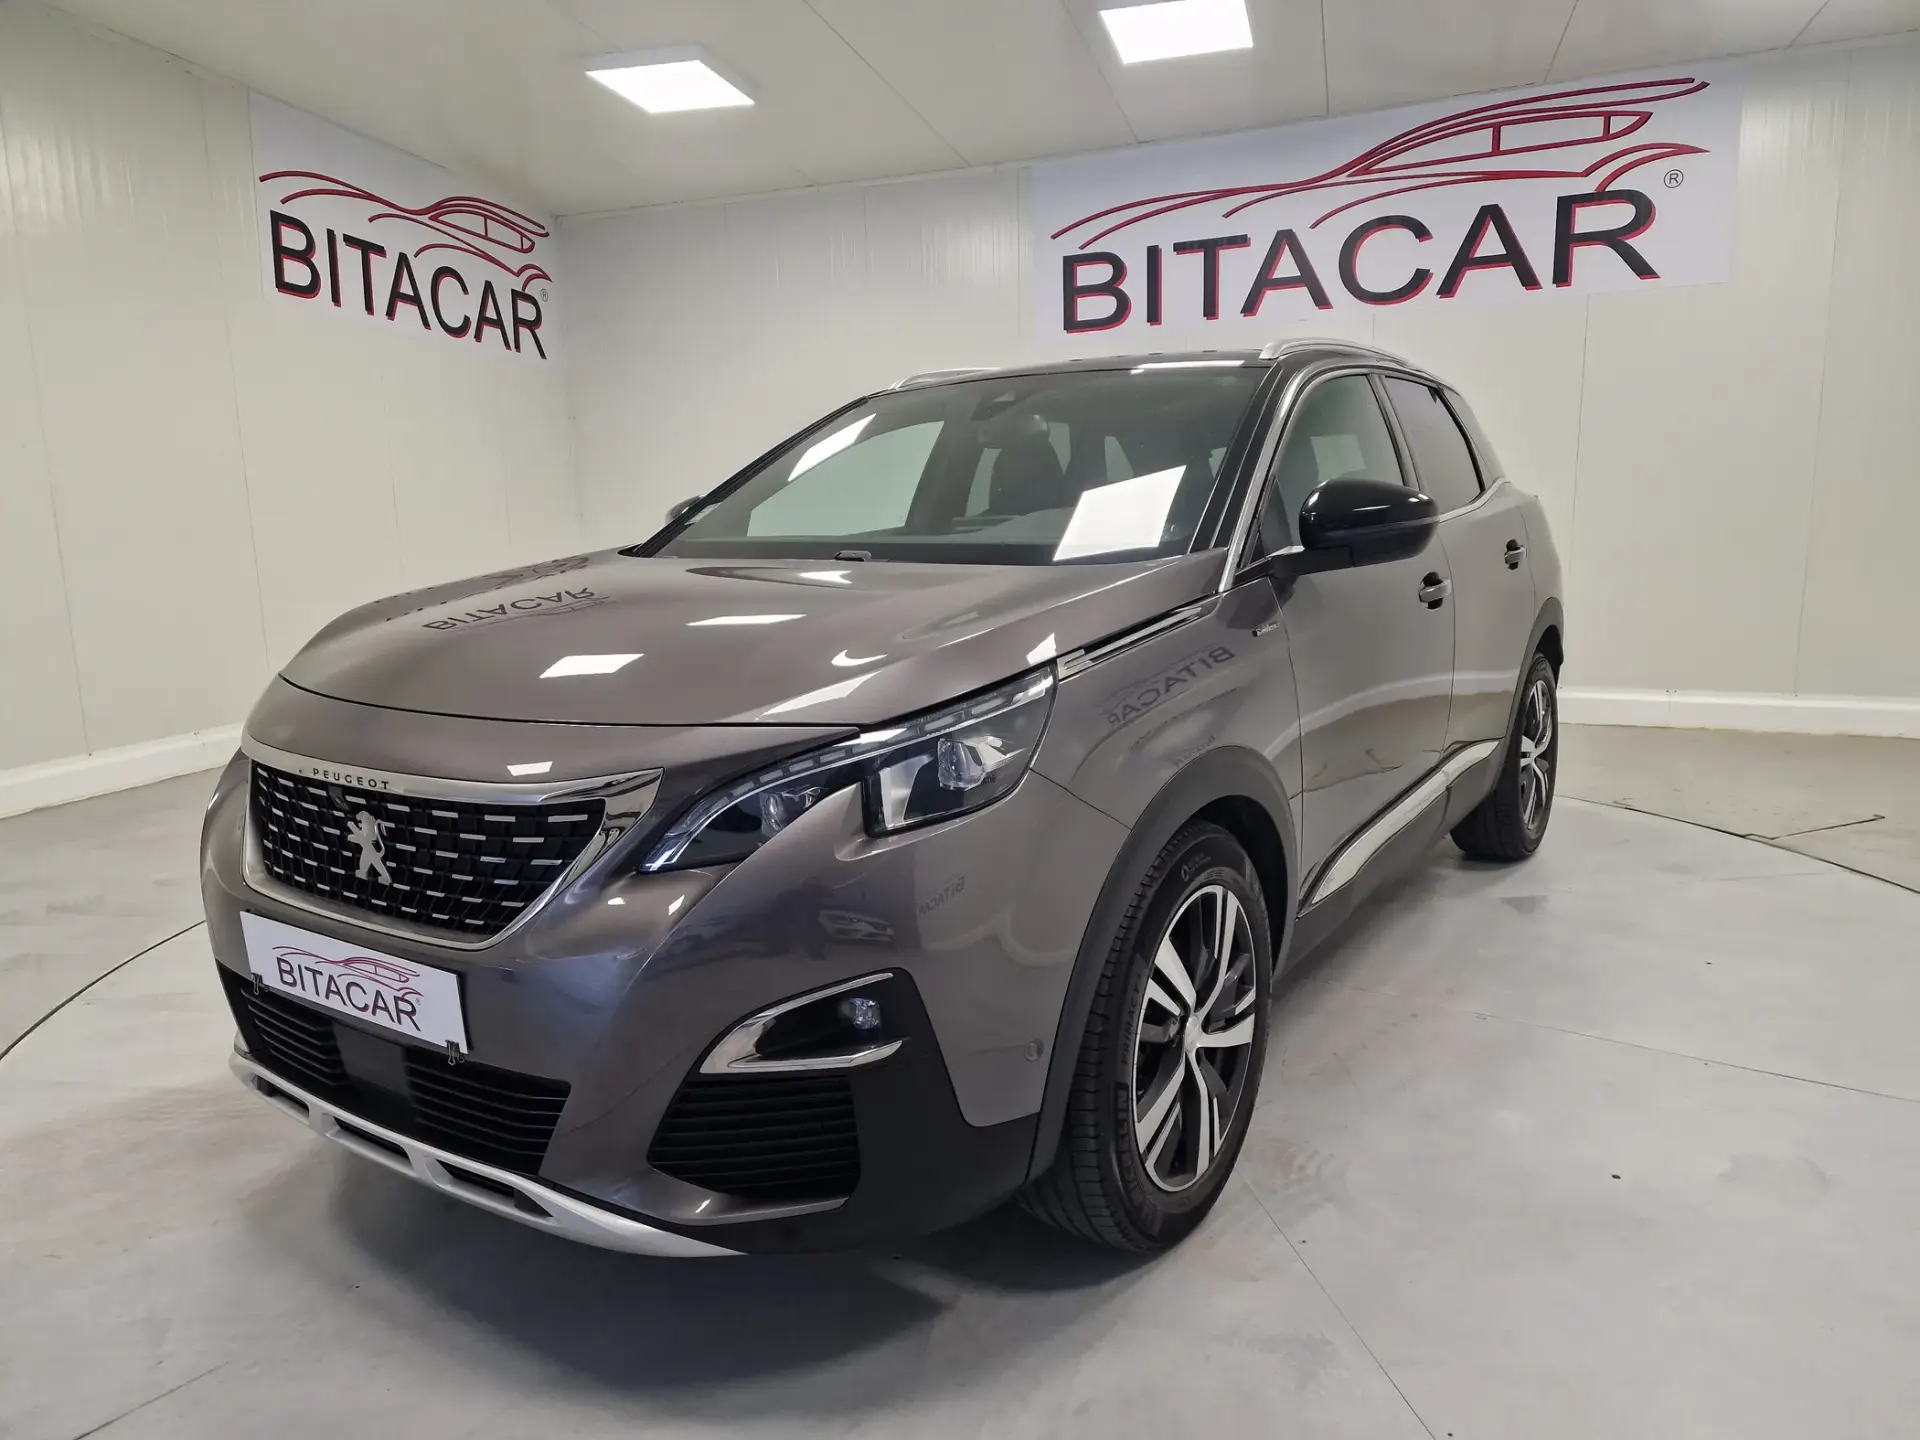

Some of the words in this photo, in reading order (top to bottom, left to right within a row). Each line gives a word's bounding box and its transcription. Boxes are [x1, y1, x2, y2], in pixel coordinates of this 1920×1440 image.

[269, 209, 547, 360] BITACAR
[1062, 189, 1660, 334] BITACAR
[312, 767, 390, 790] PEUGEOT
[275, 957, 422, 1032] BITACAR
